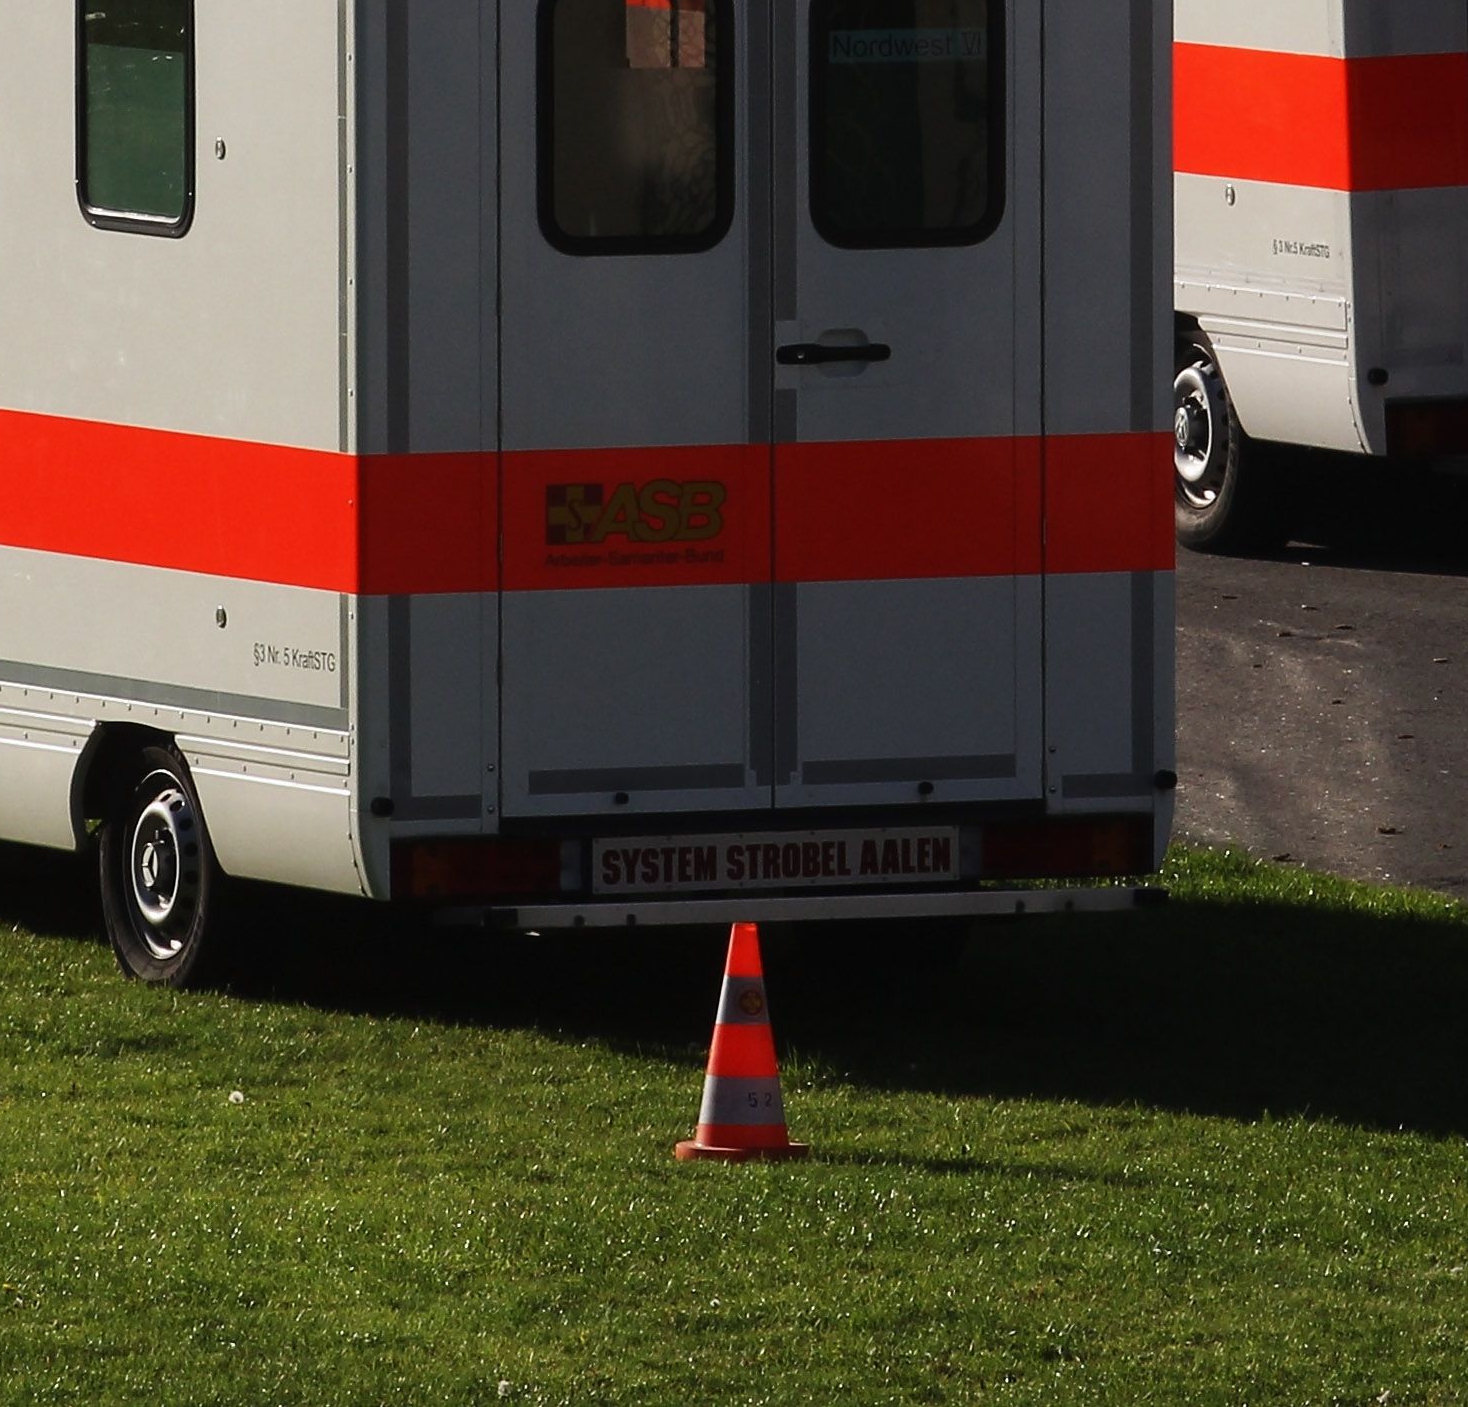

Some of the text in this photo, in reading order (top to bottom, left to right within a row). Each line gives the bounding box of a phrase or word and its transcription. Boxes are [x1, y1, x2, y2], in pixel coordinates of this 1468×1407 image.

[833, 32, 952, 58] Nordwest
[590, 477, 728, 544] ASB
[253, 642, 265, 667] §3
[267, 644, 281, 665] Nr.
[291, 648, 336, 672] KraftSTG
[601, 836, 951, 885] SYSTEM STROBEL AALEN
